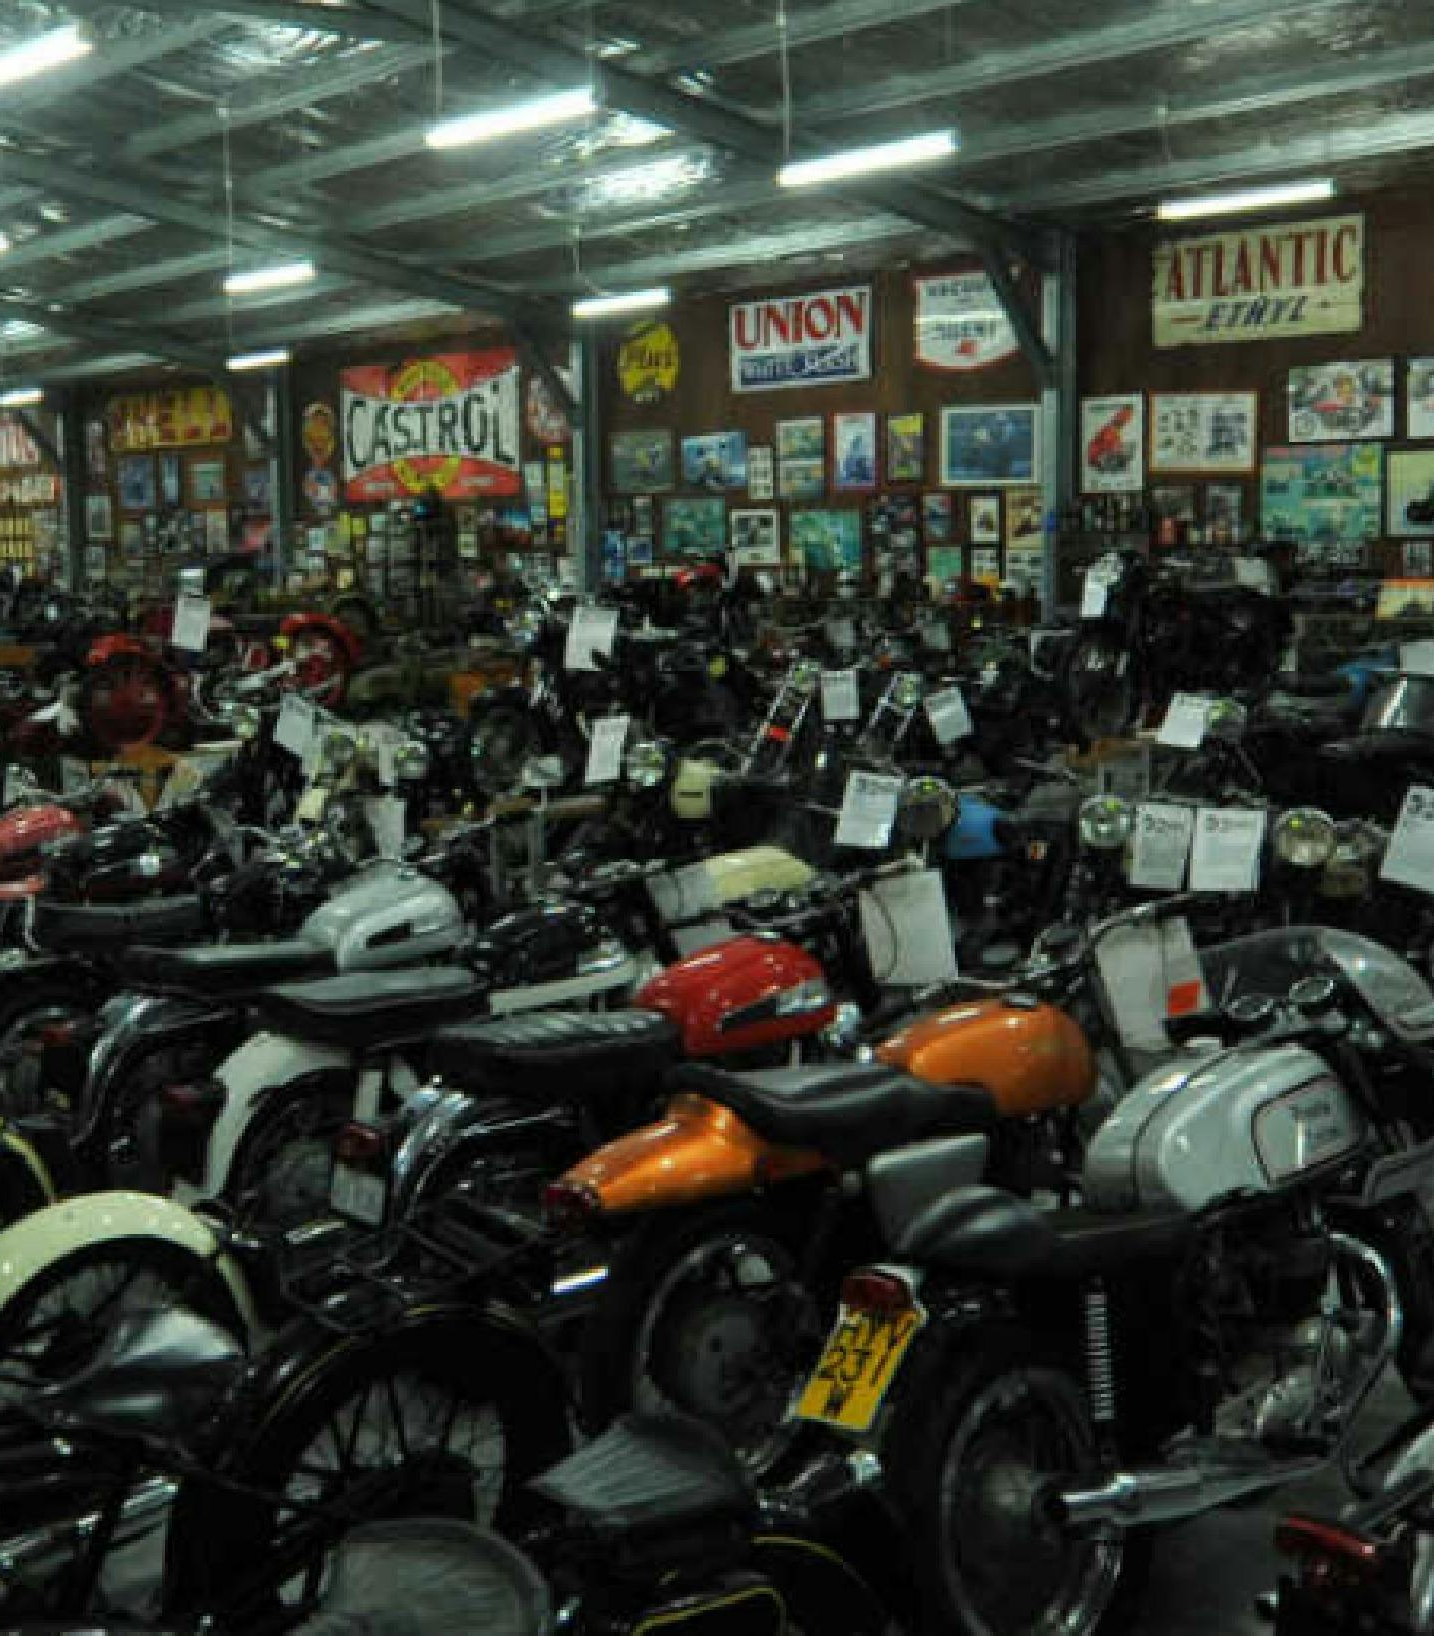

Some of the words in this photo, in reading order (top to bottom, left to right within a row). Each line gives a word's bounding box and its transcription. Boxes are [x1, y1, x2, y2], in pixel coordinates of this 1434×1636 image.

[1167, 225, 1358, 301] ATLANTIC
[734, 291, 868, 351] UNION
[346, 385, 516, 469] CASTROL
